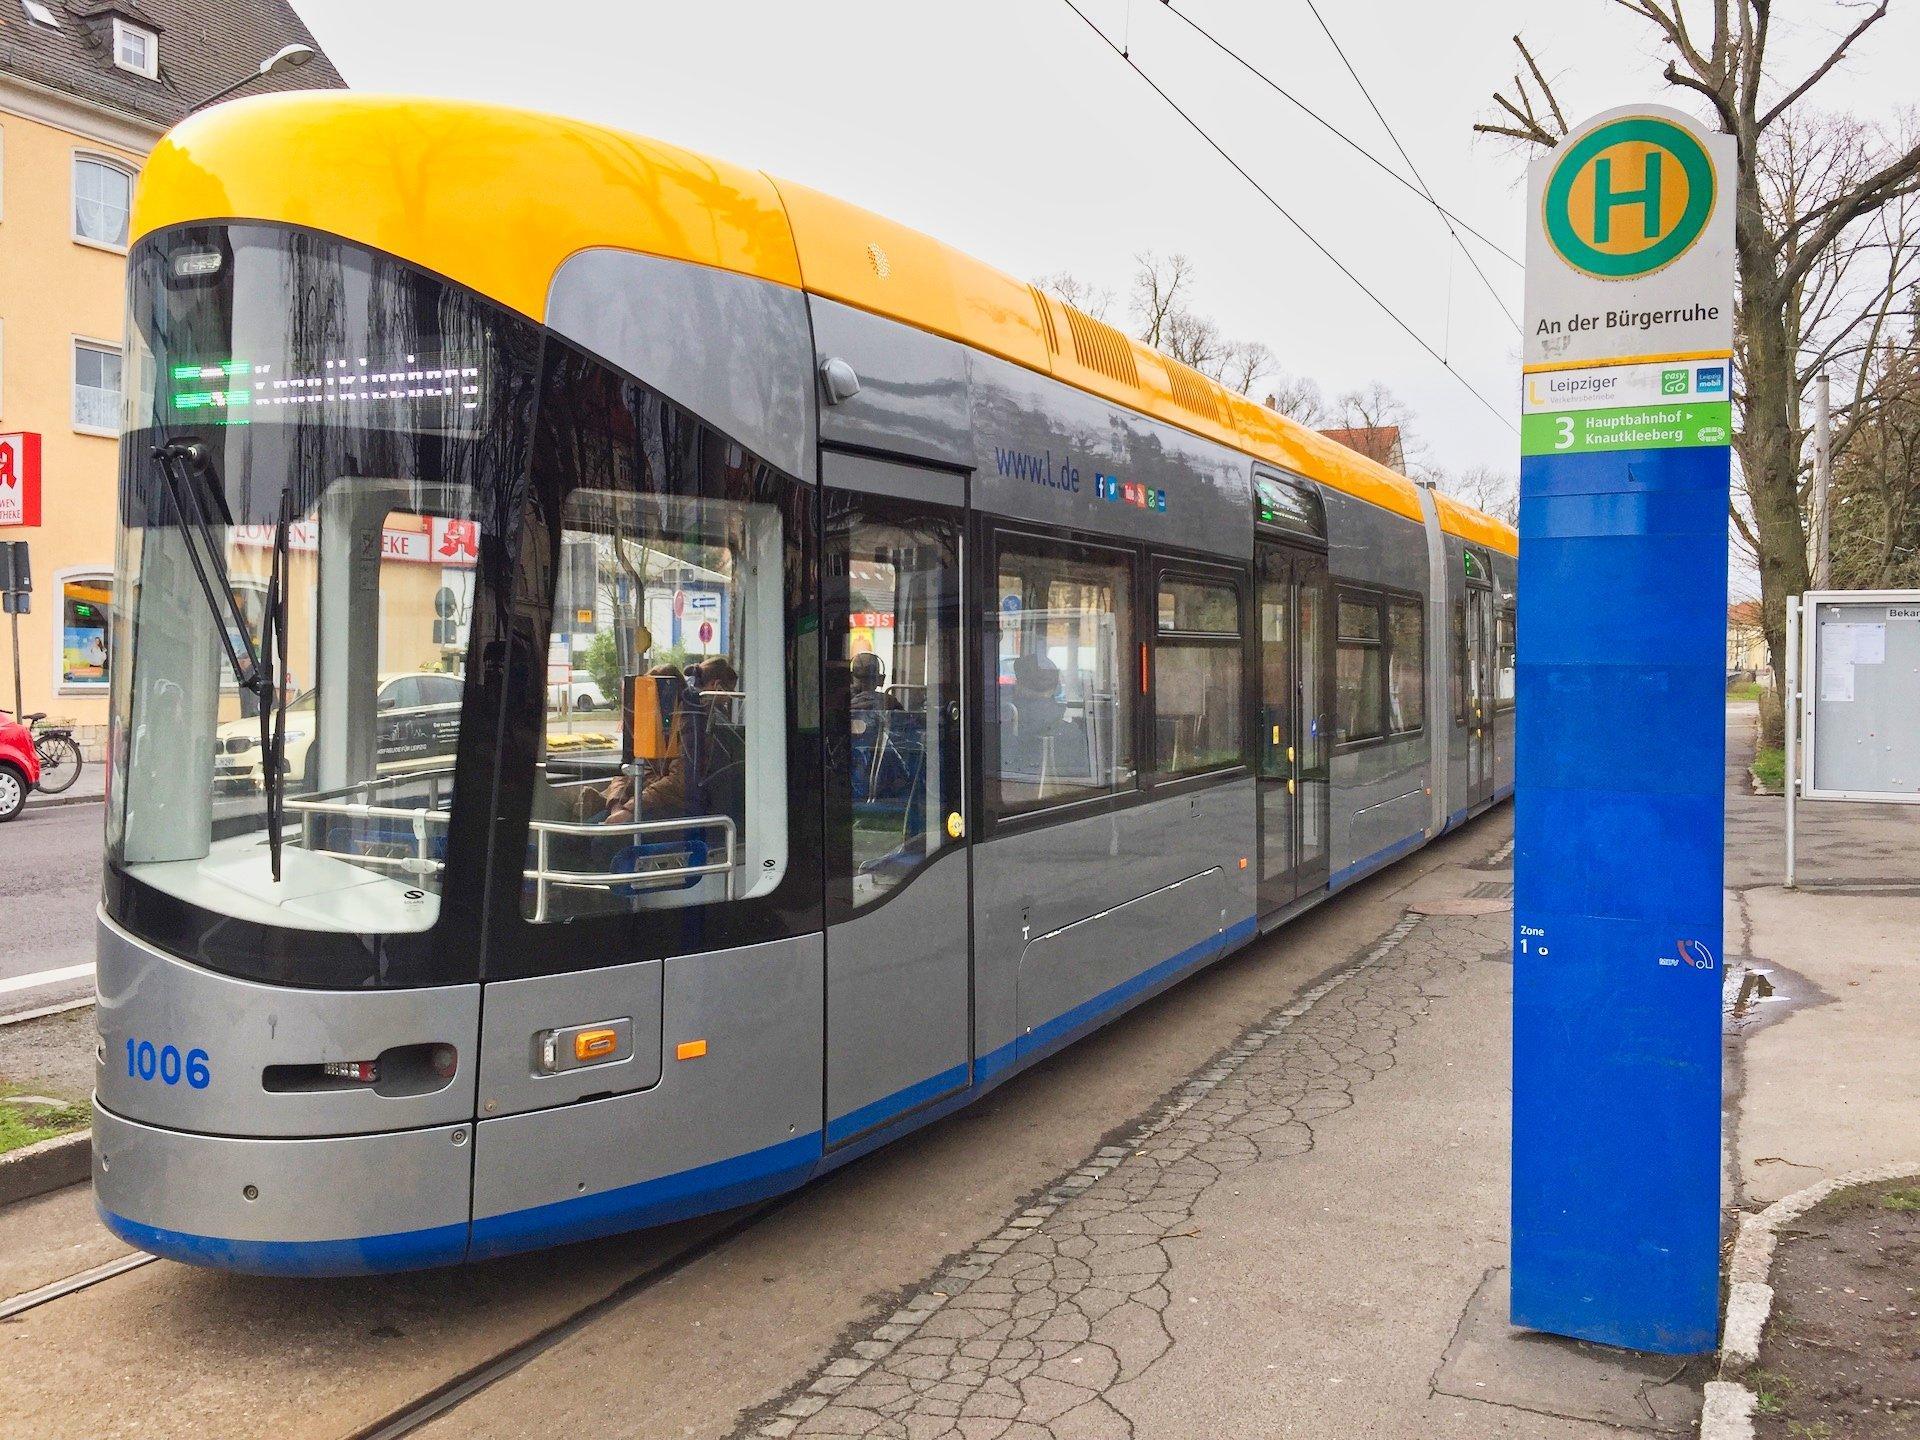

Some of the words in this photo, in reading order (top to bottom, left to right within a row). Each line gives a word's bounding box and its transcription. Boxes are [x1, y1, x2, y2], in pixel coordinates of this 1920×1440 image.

[1593, 151, 1662, 244] H
[1536, 318, 1562, 336] An
[1568, 314, 1600, 332] der
[1606, 303, 1719, 330] Bürgerruhe
[1550, 375, 1618, 394] Leipziger
[1664, 382, 1686, 393] GO
[1699, 379, 1721, 387] mobil
[1550, 392, 1615, 405] Verkehrsbetriebe
[1586, 410, 1682, 429] Hauptbahnhof
[1554, 416, 1575, 450] 3
[1586, 429, 1684, 445] Knautkleeberg
[995, 446, 1080, 493] www.L.de
[1520, 925, 1545, 936] Zone
[1520, 939, 1528, 954] 1
[126, 1037, 211, 1090] 1006
